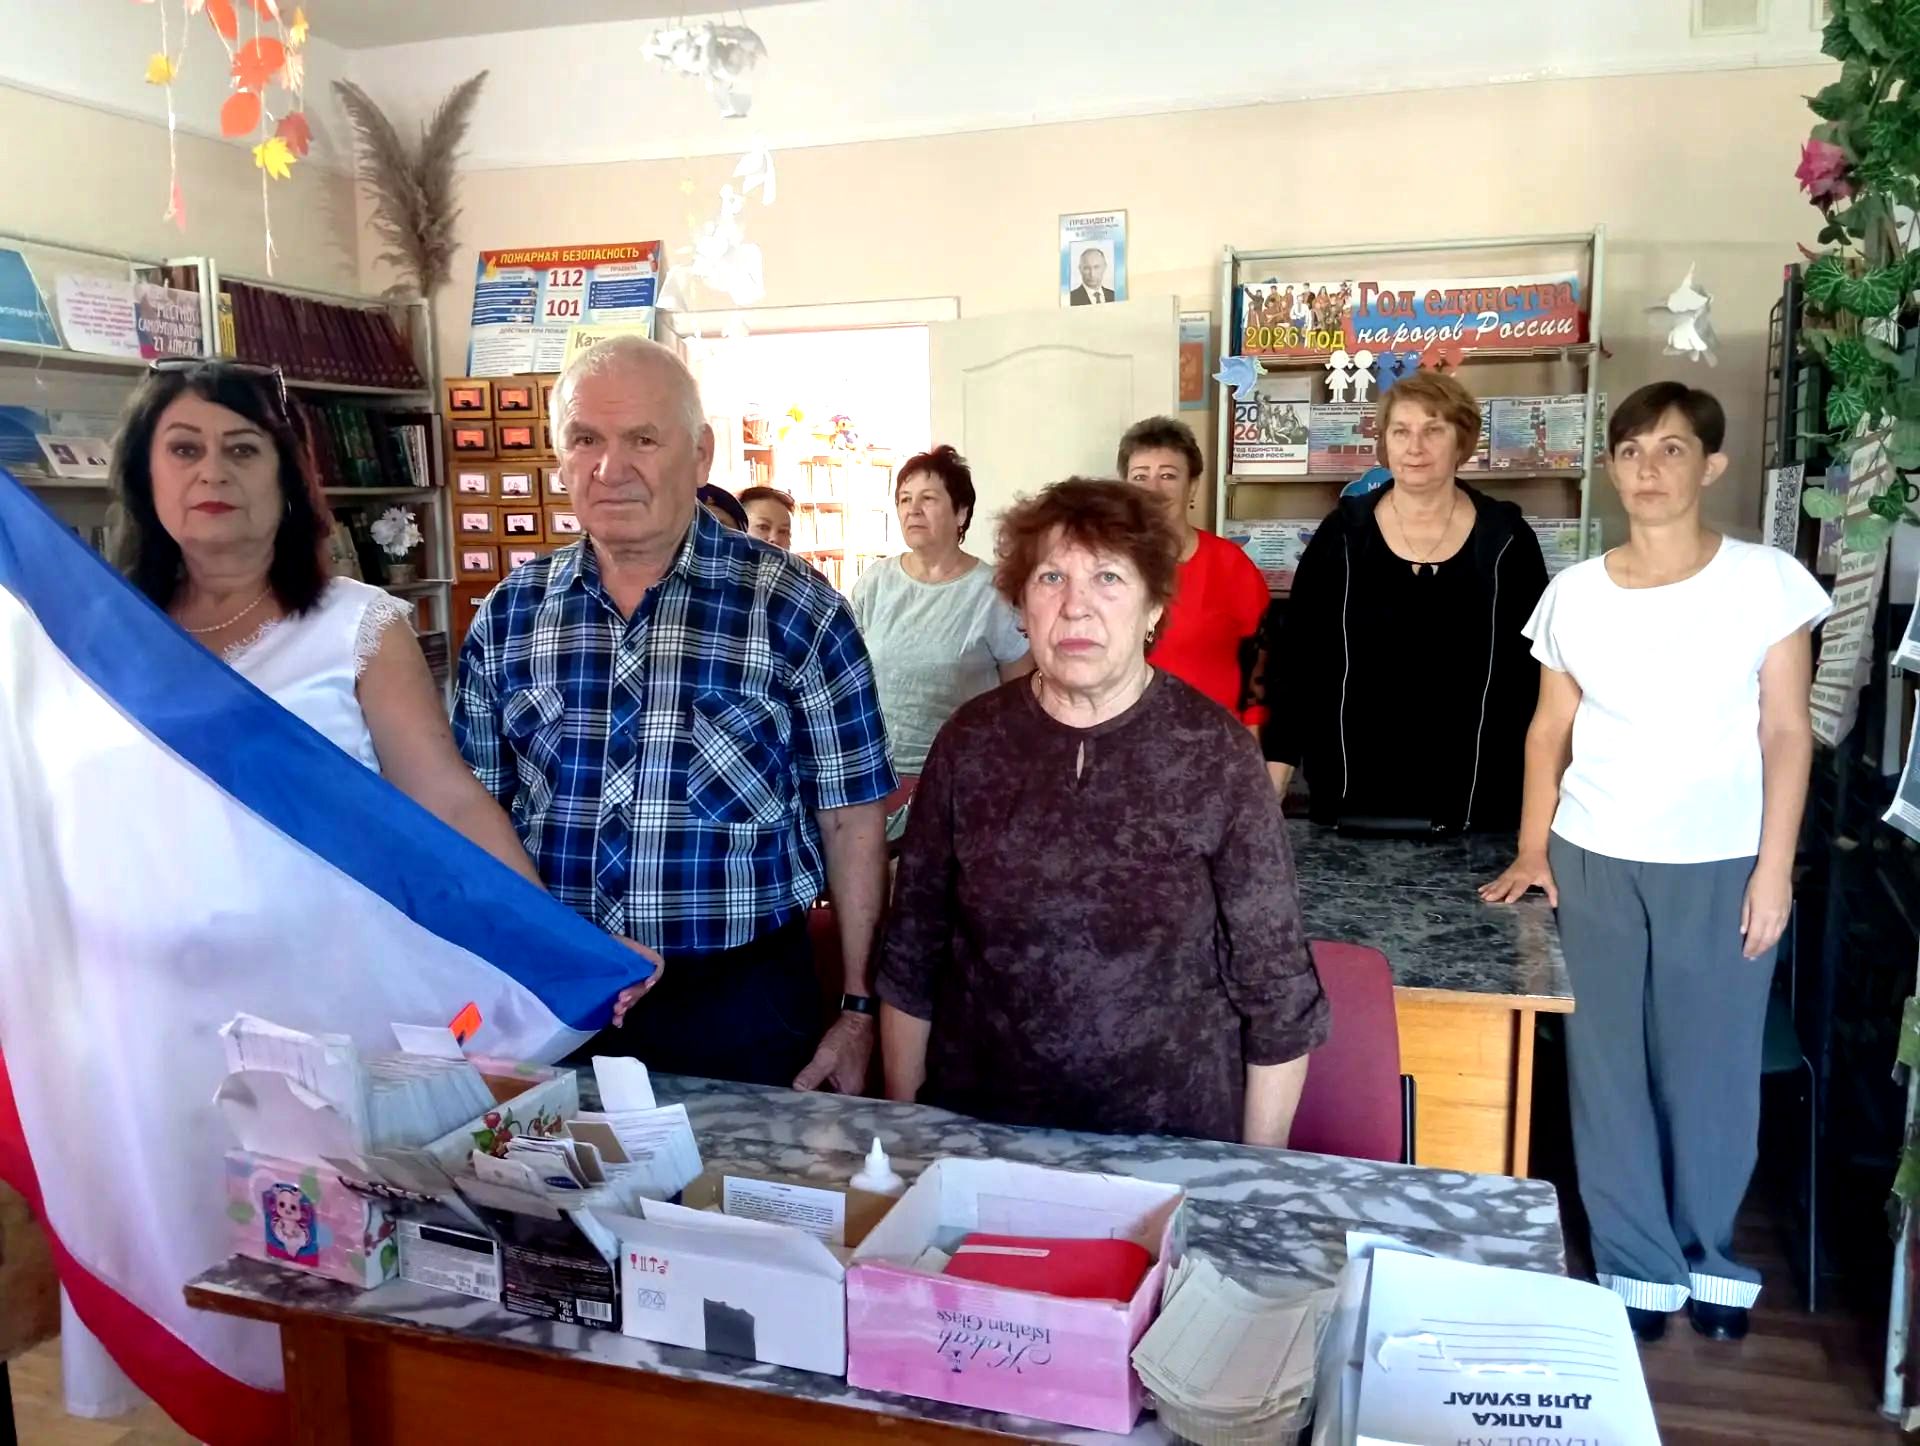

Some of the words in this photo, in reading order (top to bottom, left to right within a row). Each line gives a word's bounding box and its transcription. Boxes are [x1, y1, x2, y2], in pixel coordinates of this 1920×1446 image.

[1069, 216, 1114, 226] ПРЕЗИДЕНТ
[500, 251, 559, 264] ПОЖАРНАЯ
[563, 247, 640, 262] БЕЗОПАСНОСТЬ
[549, 269, 584, 287] 112
[1358, 281, 1415, 318] Год
[1424, 278, 1575, 316] единства
[545, 299, 580, 317] 101
[1243, 326, 1299, 350] 2026
[1305, 329, 1346, 352] год
[1357, 311, 1465, 352] народов
[1475, 311, 1574, 342] России
[1236, 405, 1259, 422] 20
[1234, 424, 1259, 440] 26
[937, 1309, 984, 1330] Glass
[988, 1313, 1051, 1344] Isfahan
[1443, 1391, 1530, 1407] БУМАГ
[1538, 1393, 1592, 1410] ДЛЯ
[1472, 1413, 1562, 1428] ПАПКА
